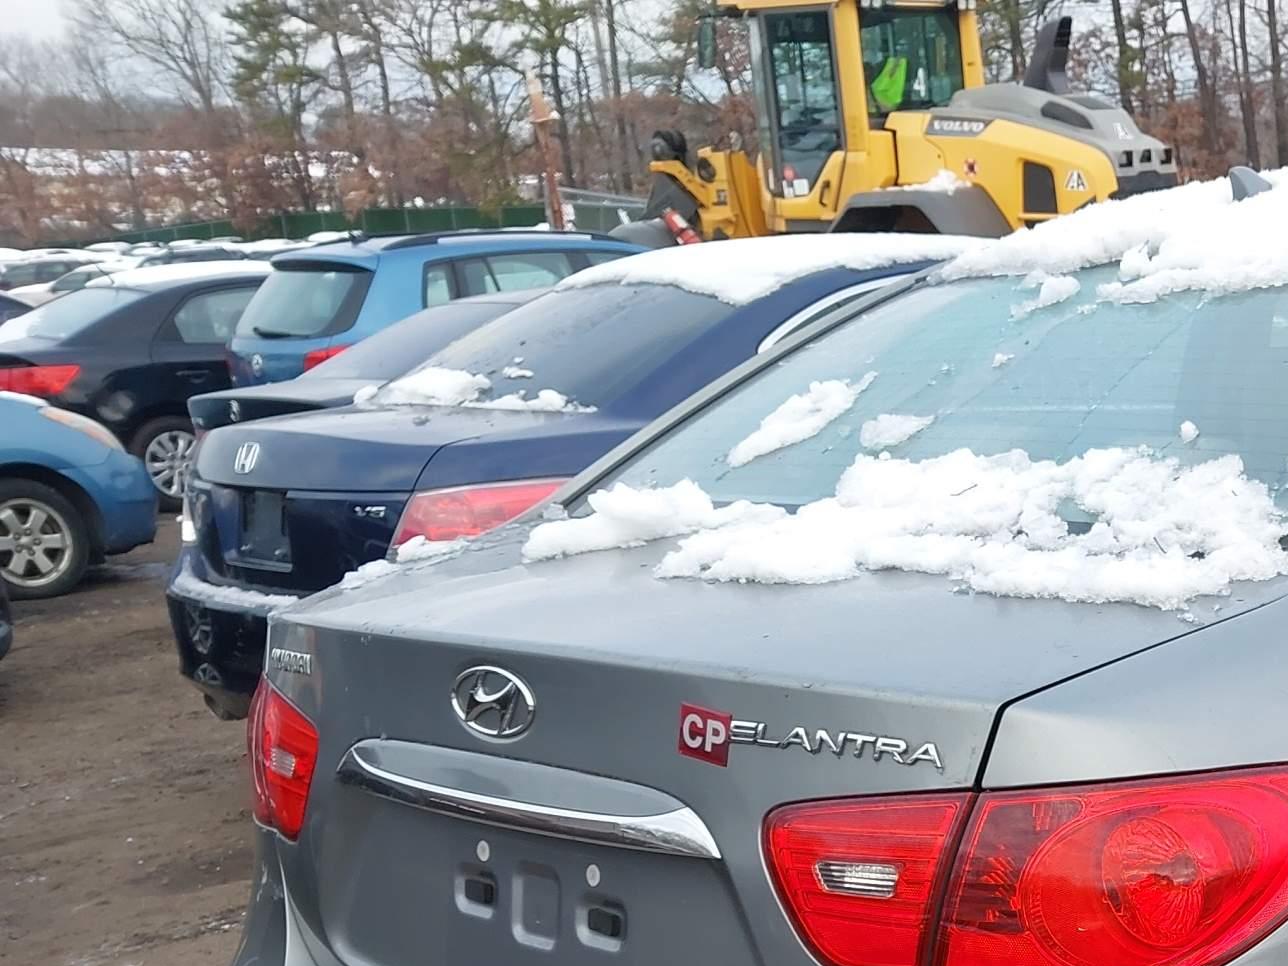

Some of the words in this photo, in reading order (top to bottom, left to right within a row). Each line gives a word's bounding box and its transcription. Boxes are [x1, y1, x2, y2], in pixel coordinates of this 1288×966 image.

[912, 67, 926, 97] 4
[933, 119, 985, 133] VOLVO
[682, 712, 726, 753] CP
[730, 719, 943, 769] ELANTRA
